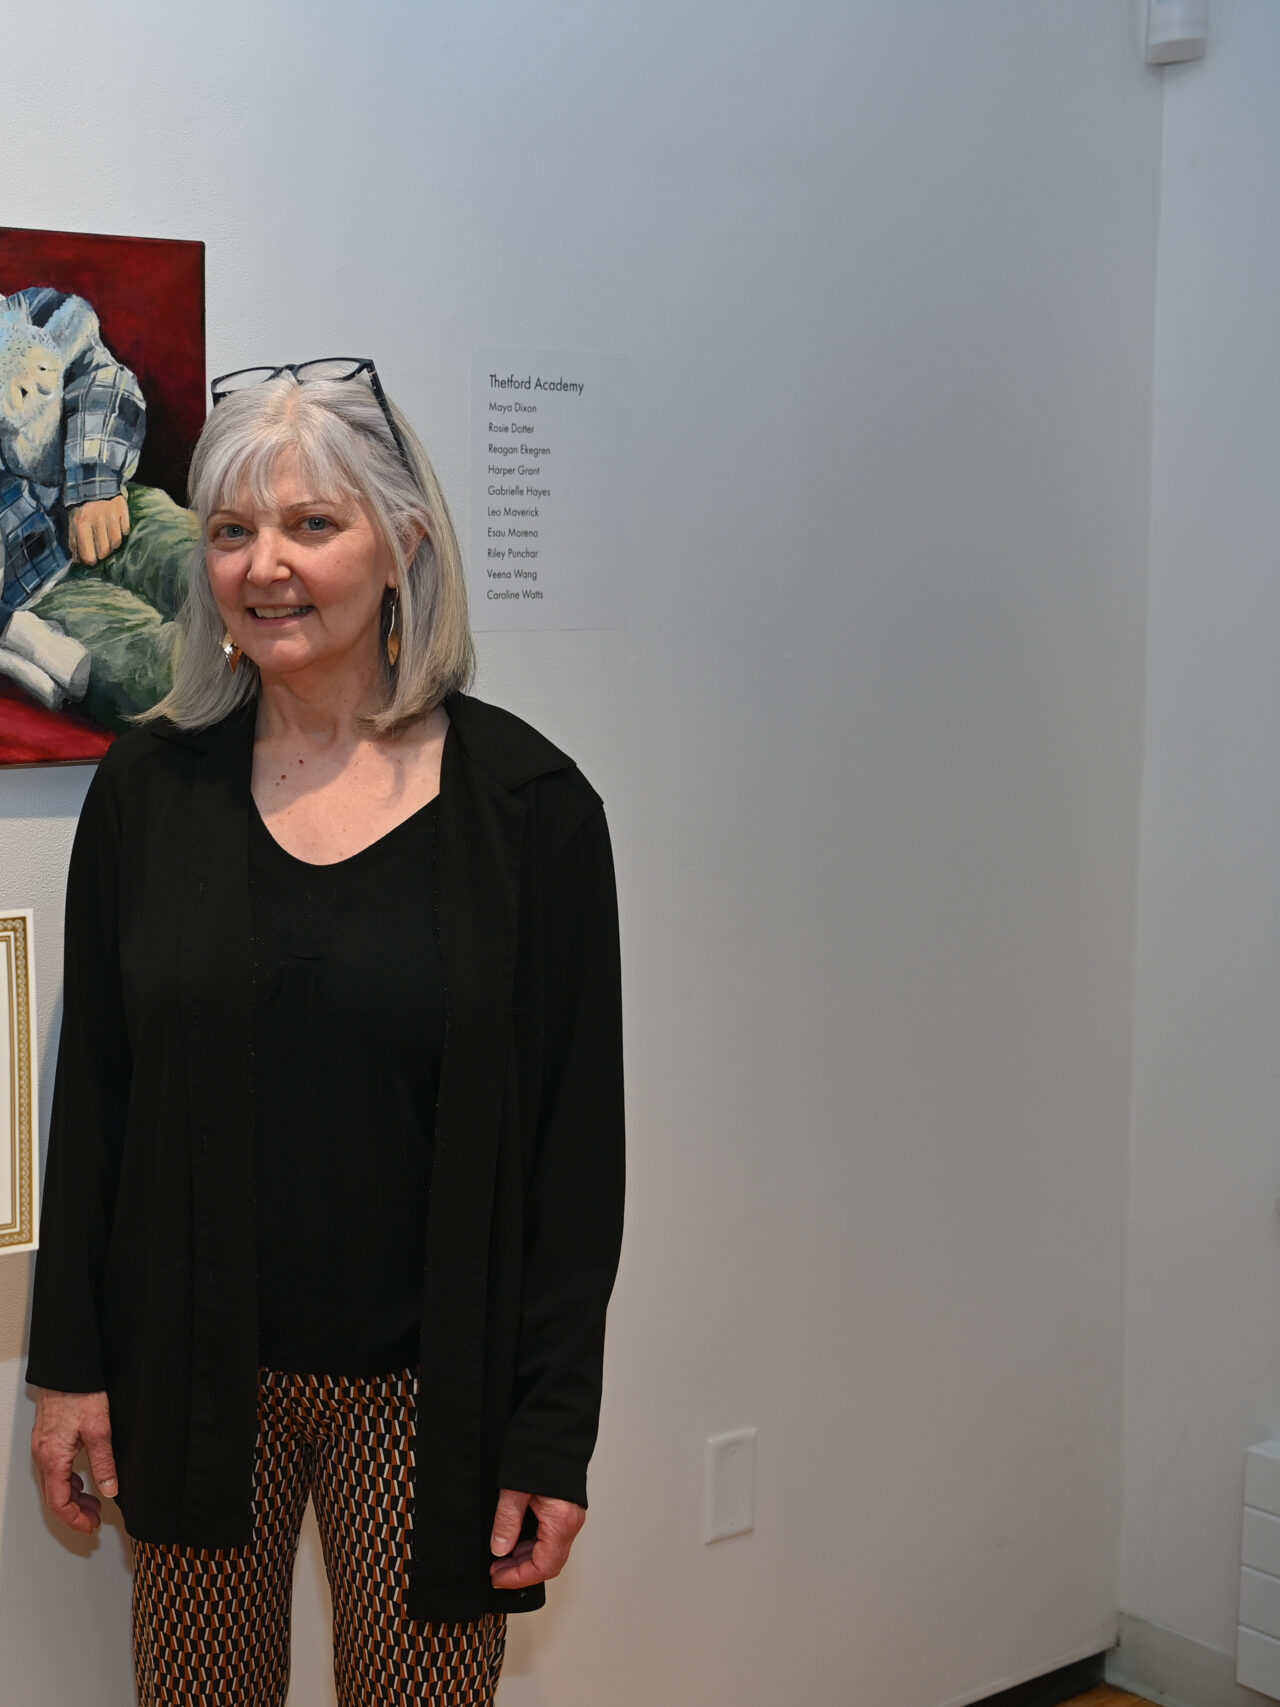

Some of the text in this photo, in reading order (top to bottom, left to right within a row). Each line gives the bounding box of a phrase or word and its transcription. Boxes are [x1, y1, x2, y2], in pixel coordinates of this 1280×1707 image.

[489, 374, 584, 395] Thetford Academy
[488, 402, 537, 414] Maya Dixon
[488, 423, 509, 433] Rosie
[488, 444, 551, 458] Reagan Ekegren
[488, 465, 540, 477] Harper Grant
[487, 485, 551, 498] Gabrielle Hayes
[487, 507, 539, 517] Leo Maverick
[487, 528, 538, 538] Esau Moreno
[487, 548, 538, 560] Riley Punchar
[487, 569, 537, 581] Veena Wang
[487, 589, 544, 600] Caroline Watts
